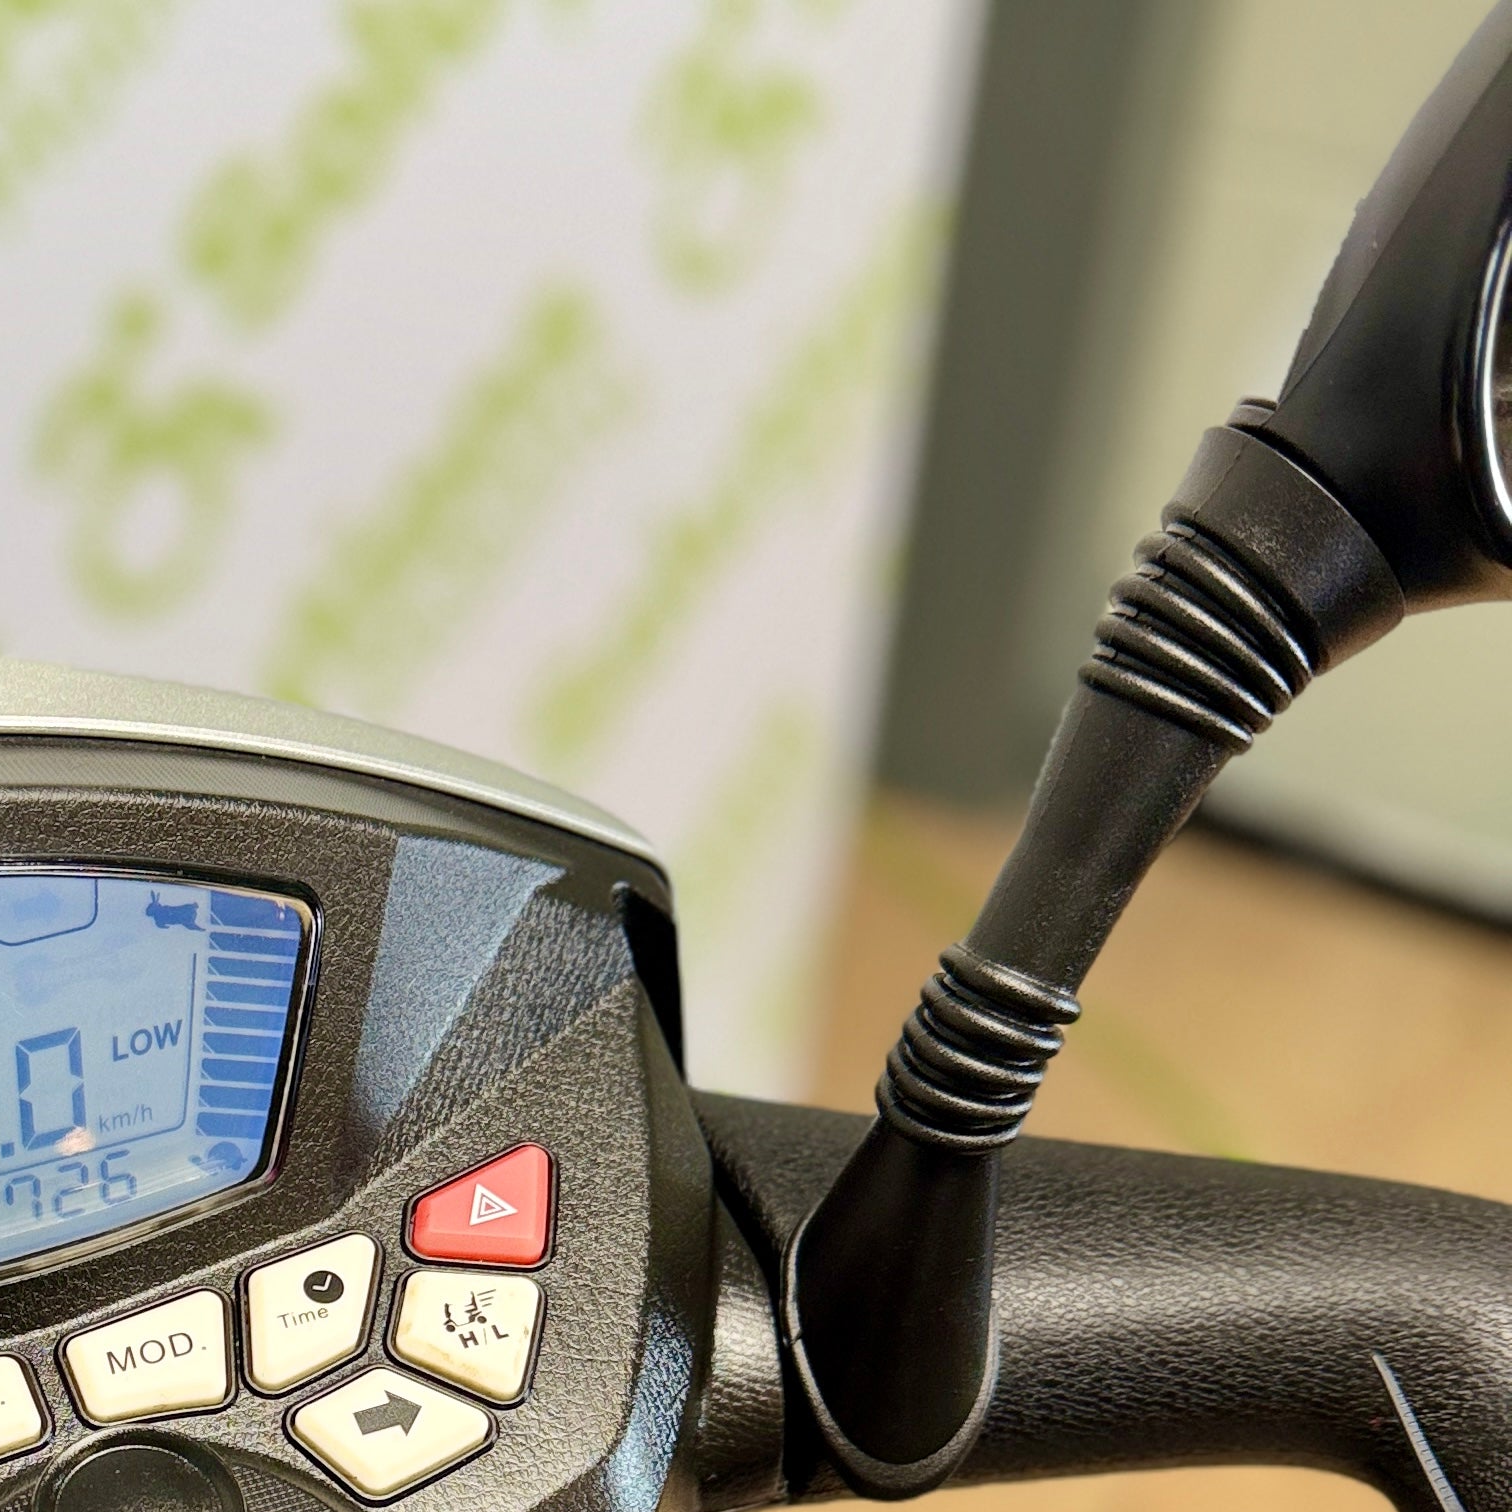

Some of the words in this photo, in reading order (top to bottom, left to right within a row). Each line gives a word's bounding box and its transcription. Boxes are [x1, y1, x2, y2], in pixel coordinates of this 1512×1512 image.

[112, 1019, 183, 1062] LOW
[99, 1104, 153, 1133] km/h
[4, 1150, 138, 1221] 726
[277, 1305, 329, 1329] Time
[106, 1331, 208, 1375] MOD.
